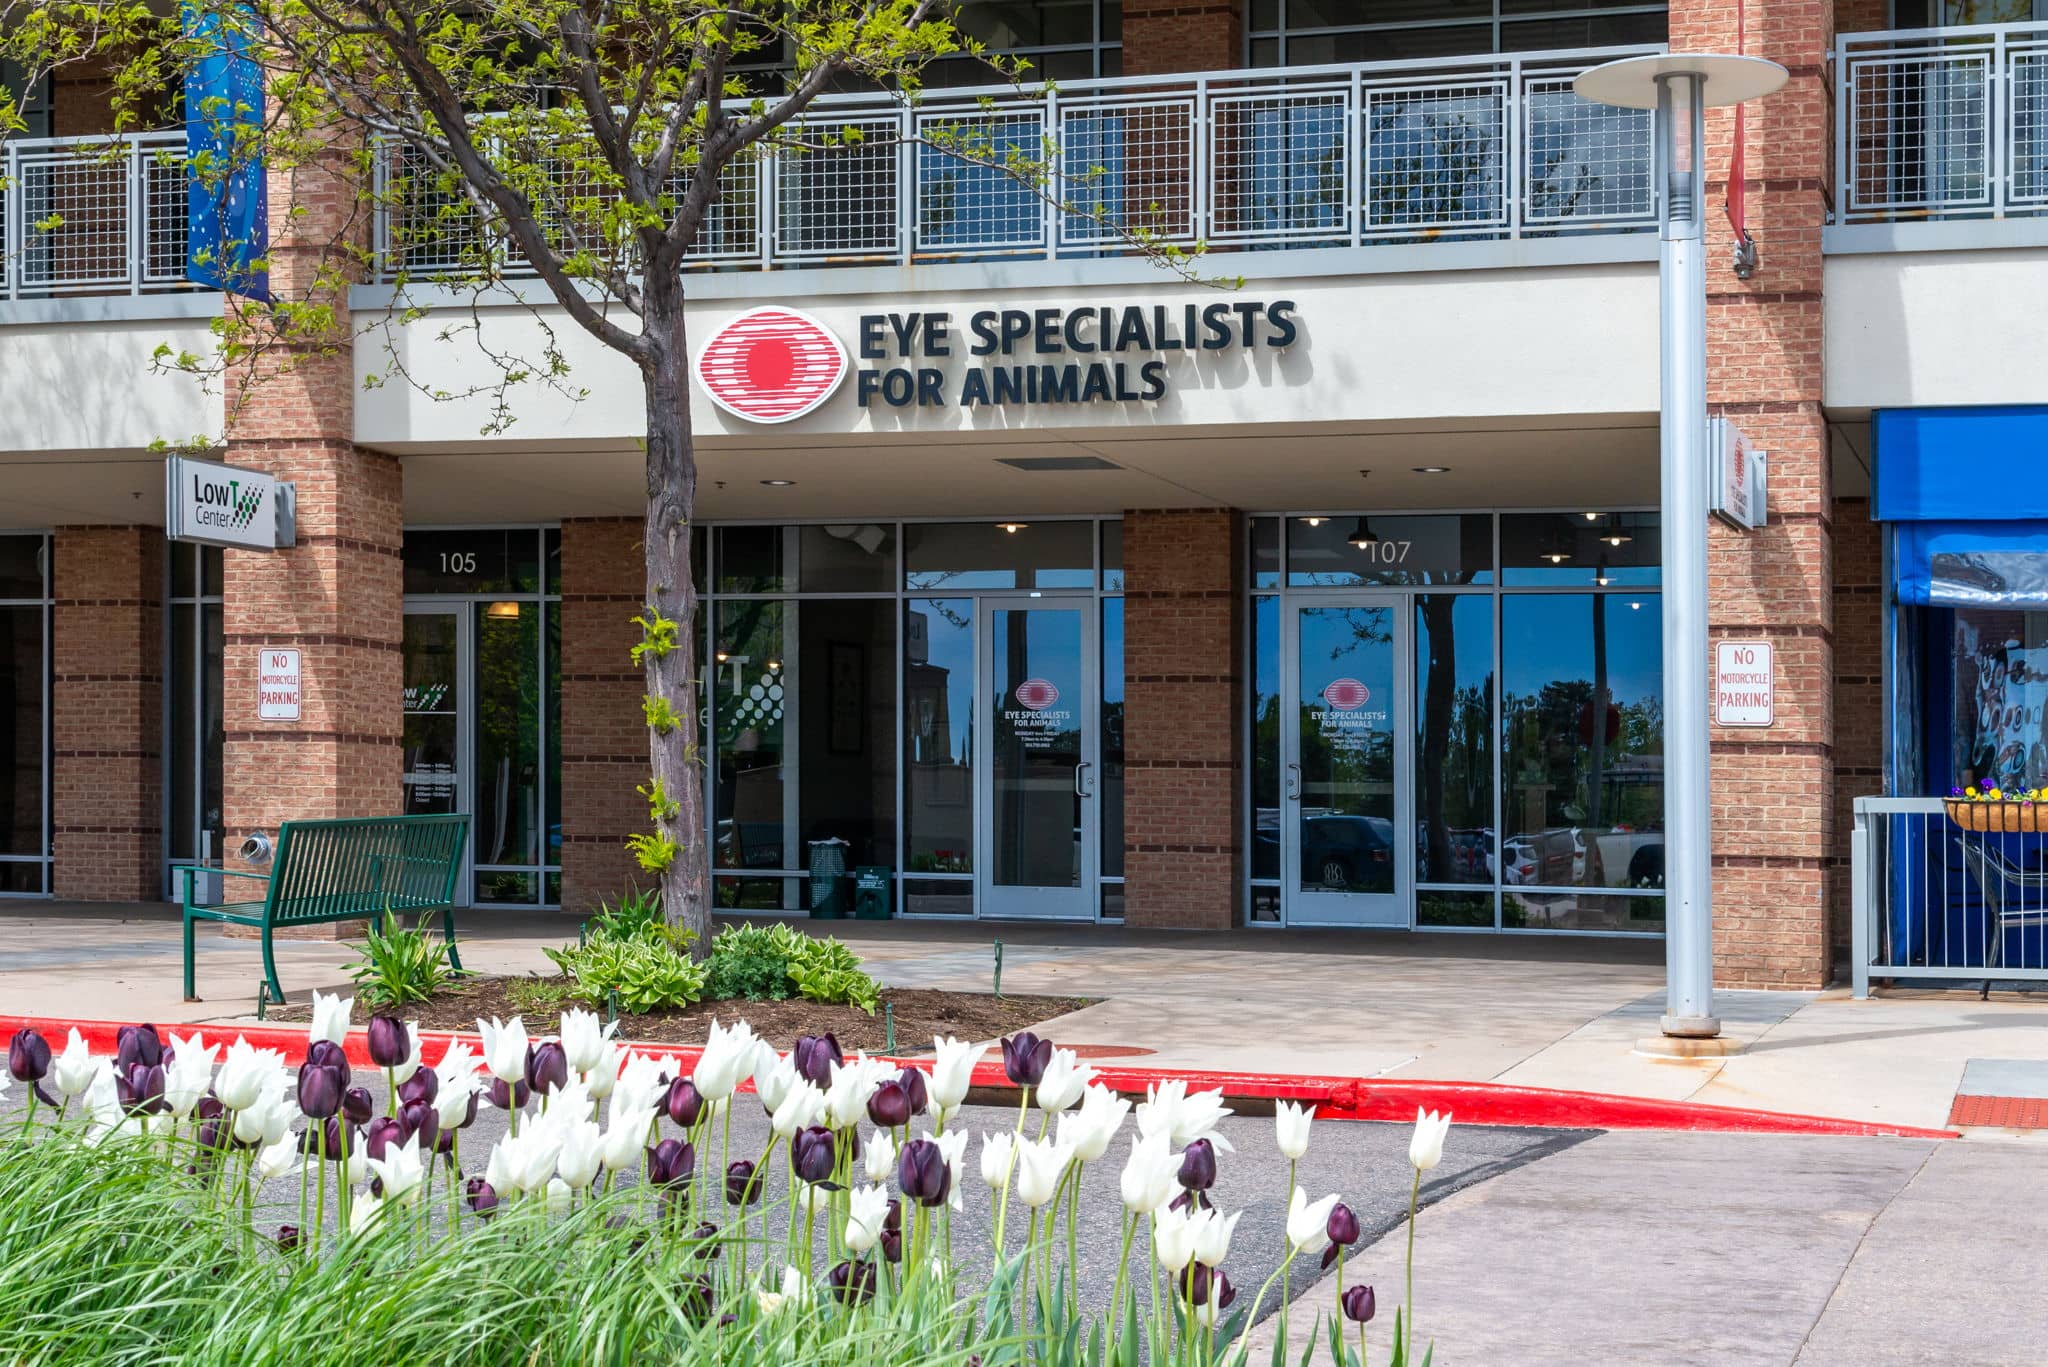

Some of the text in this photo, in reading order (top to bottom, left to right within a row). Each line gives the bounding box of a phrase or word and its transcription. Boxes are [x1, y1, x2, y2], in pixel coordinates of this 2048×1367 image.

[859, 300, 1297, 359] EYE SPECIALISTS
[858, 361, 1166, 408] FOR ANIMALS
[195, 505, 231, 529] Center
[1369, 541, 1411, 564] 107
[440, 552, 476, 574] 105
[272, 654, 288, 668] NO
[1734, 649, 1755, 666] NO
[262, 674, 297, 686] MOTORCYCLE
[1720, 672, 1769, 685] MOTORCYCLE
[261, 691, 298, 706] PARKING
[1720, 691, 1769, 709] PARKING
[1005, 711, 1070, 720] EYE SPECIALISTS
[1014, 719, 1061, 727] FOR ANIMALS
[1311, 711, 1382, 721] EYE SPECIALISTS
[1321, 720, 1372, 728] FOR ANIMALS
